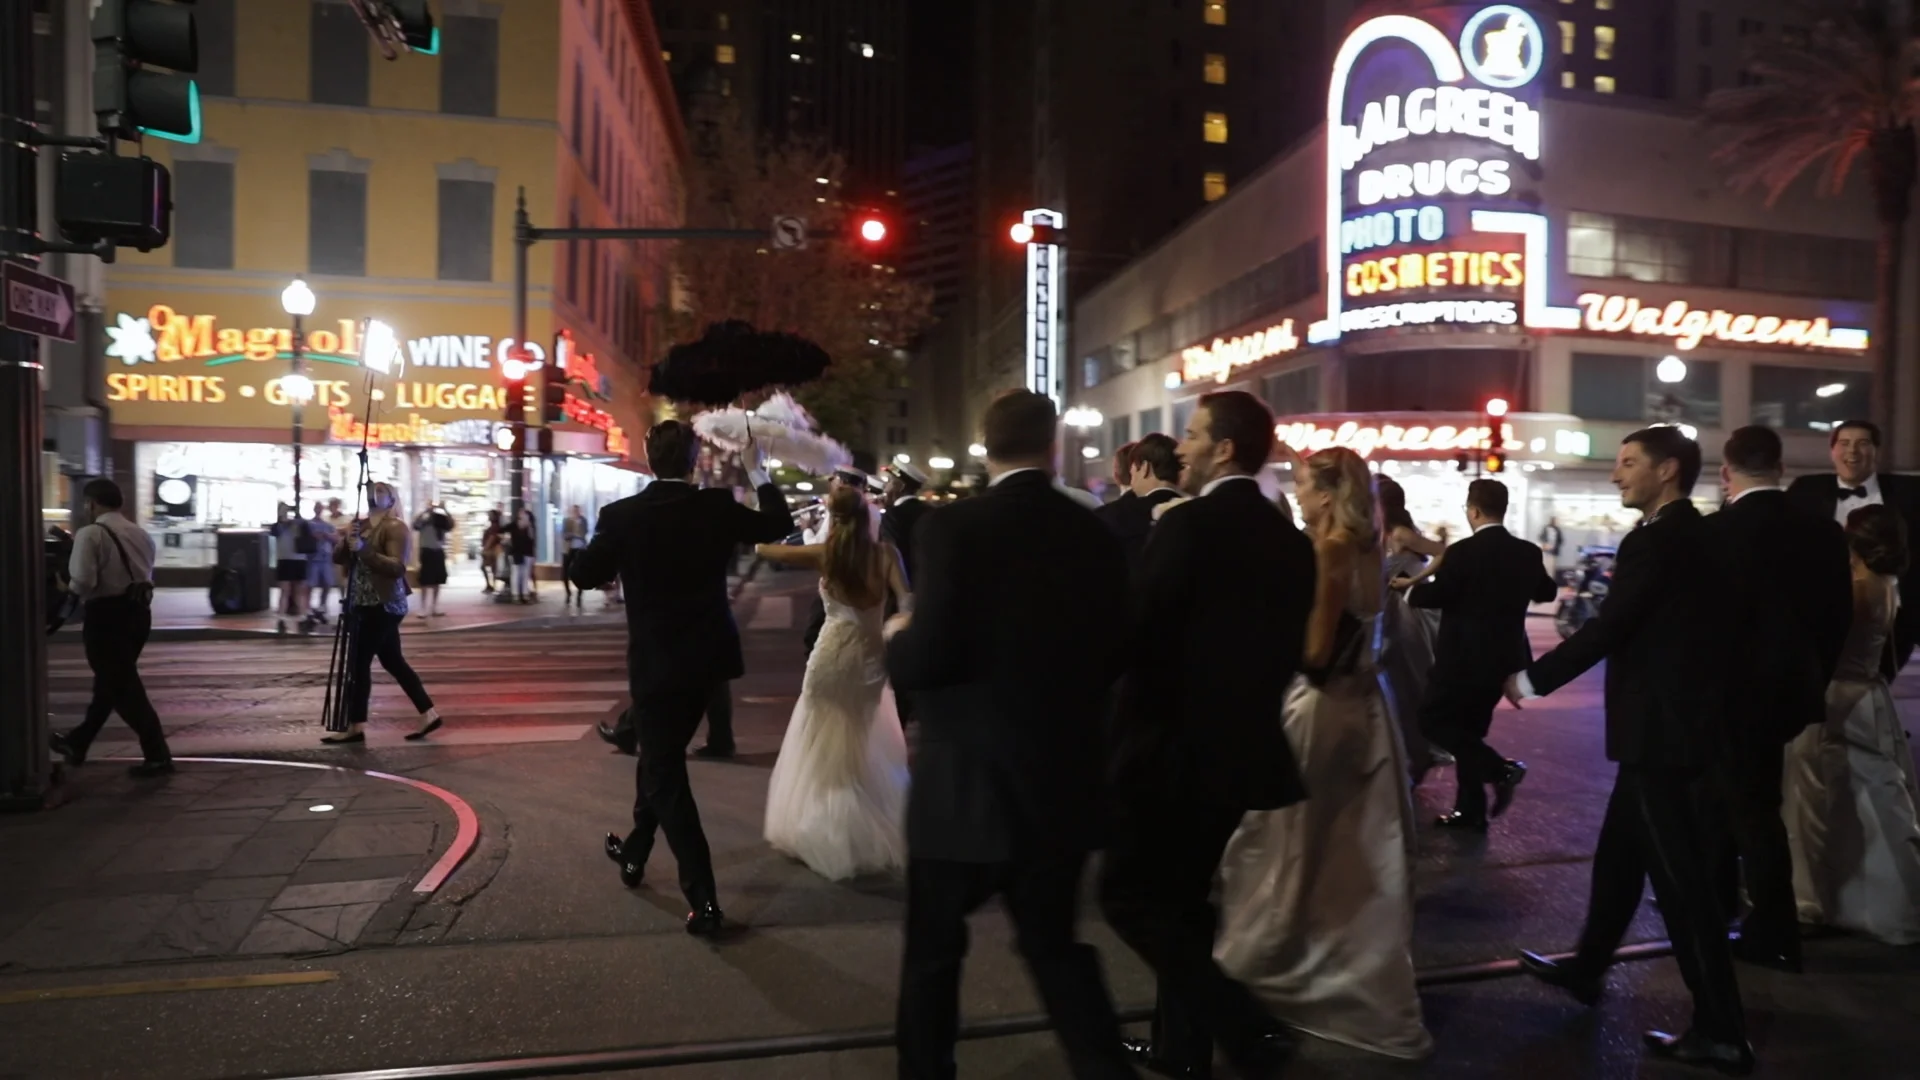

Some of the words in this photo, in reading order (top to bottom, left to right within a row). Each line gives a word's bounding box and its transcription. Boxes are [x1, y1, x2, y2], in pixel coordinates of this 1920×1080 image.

[1358, 158, 1511, 206] DRUGS
[1341, 205, 1444, 254] PHOTO
[1346, 251, 1524, 296] COSMETICS
[1577, 292, 1831, 350] Walgreens
[408, 335, 492, 369] WINE
[106, 372, 226, 403] SPIRITS
[263, 379, 351, 407] GTS
